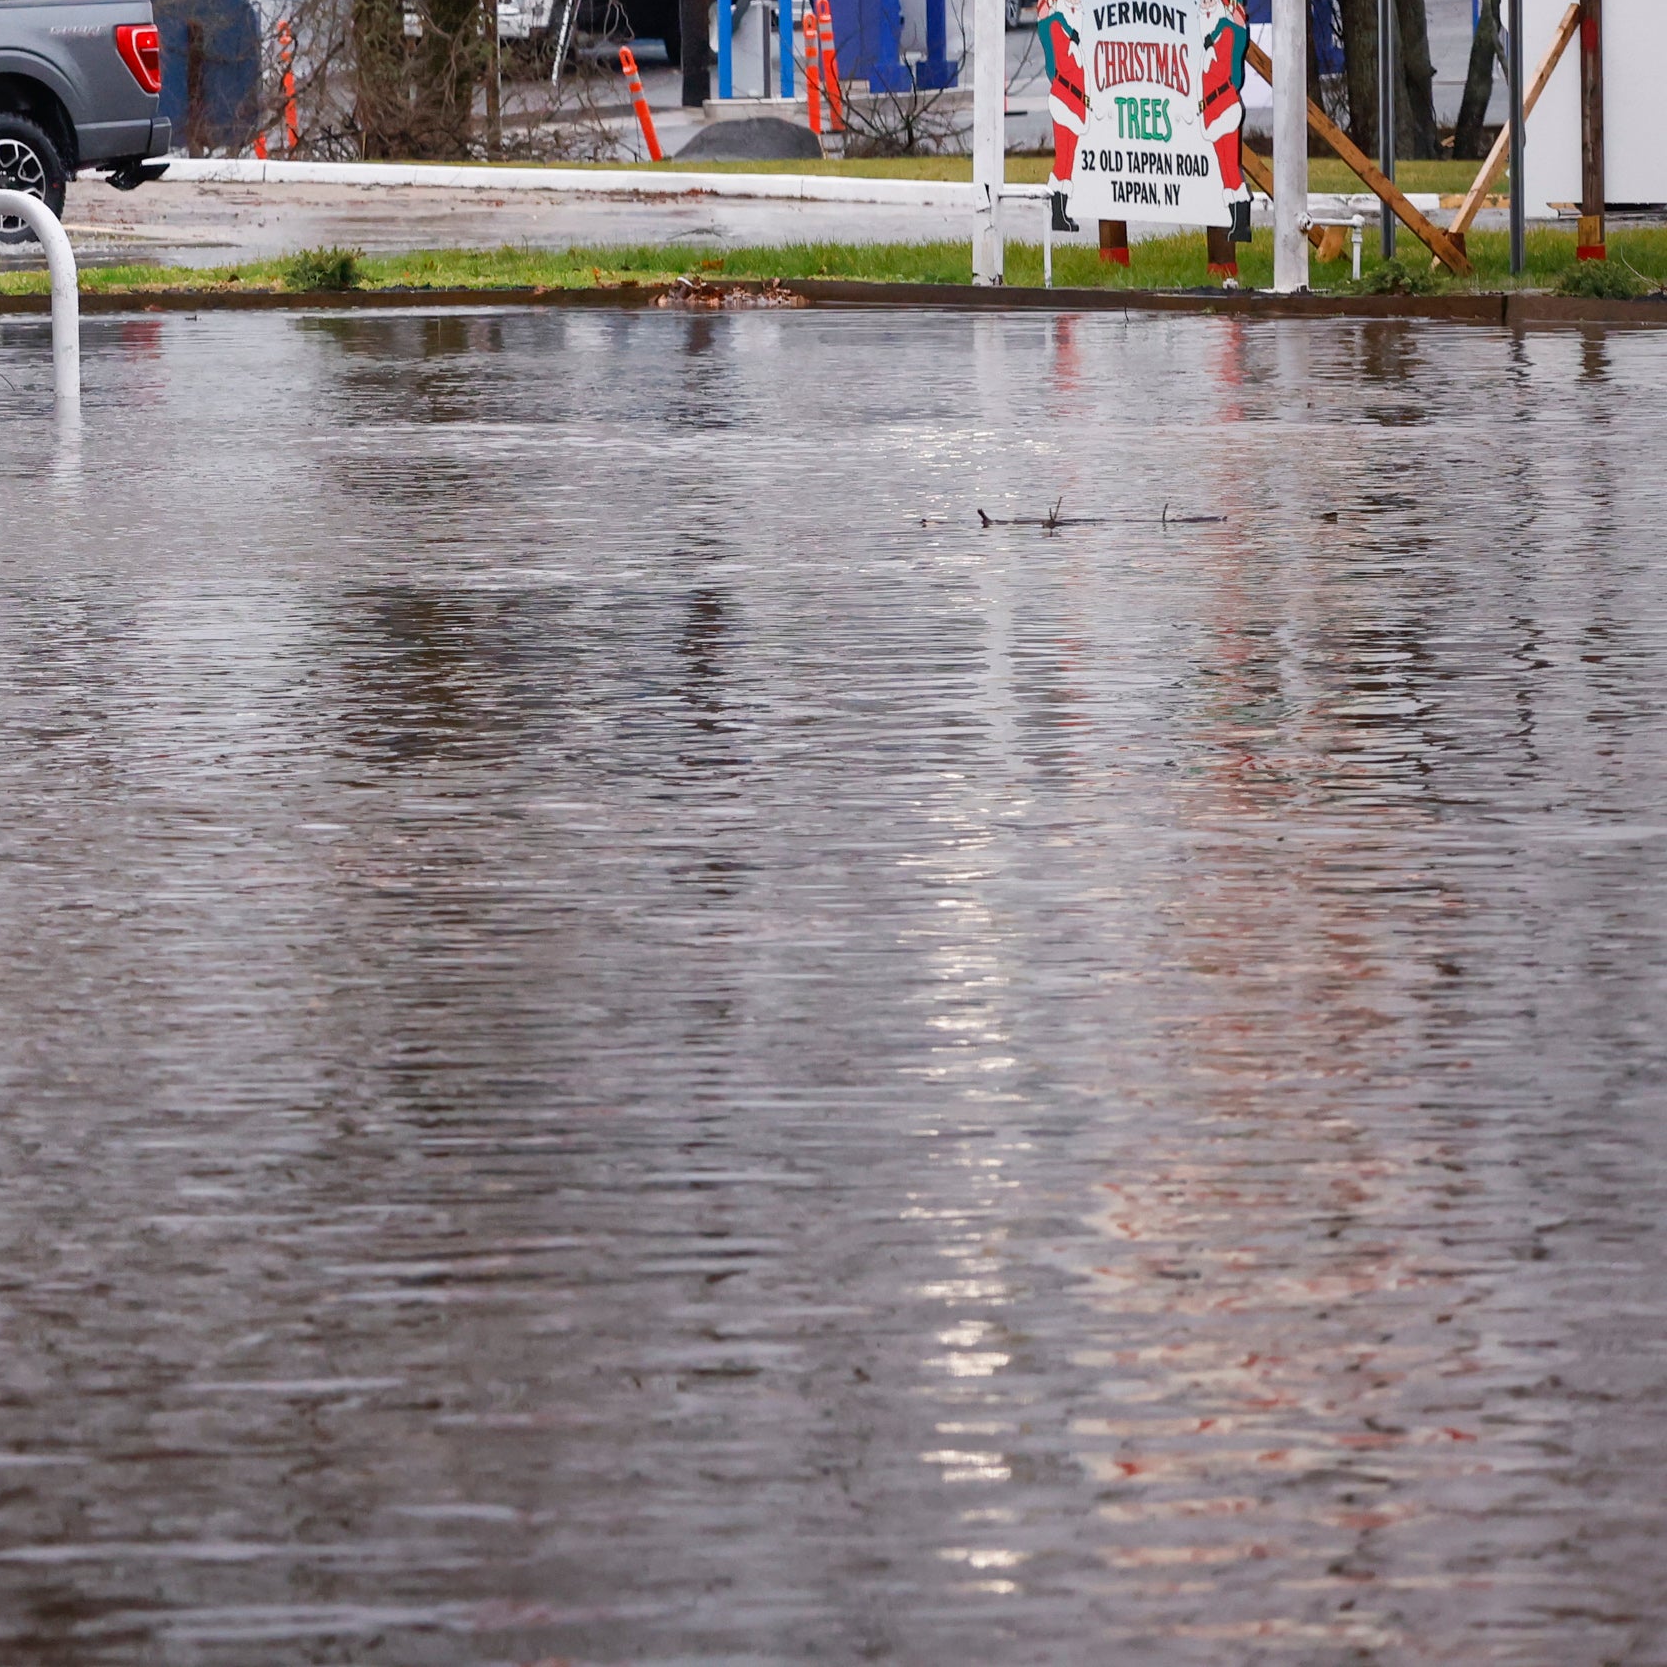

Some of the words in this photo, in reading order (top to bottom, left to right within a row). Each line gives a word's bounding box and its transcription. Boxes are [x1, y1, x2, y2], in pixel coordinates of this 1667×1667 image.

[1093, 1, 1188, 35] VERMONT
[1093, 39, 1191, 97] CHRISTMAS
[1114, 96, 1173, 143] TREES
[1081, 149, 1096, 172] 32
[1099, 150, 1123, 173] OLD
[1126, 151, 1173, 176] TAPPAN
[1176, 154, 1210, 178] ROAD
[1111, 181, 1161, 208] TAPPAN,
[1163, 184, 1181, 206] NY
